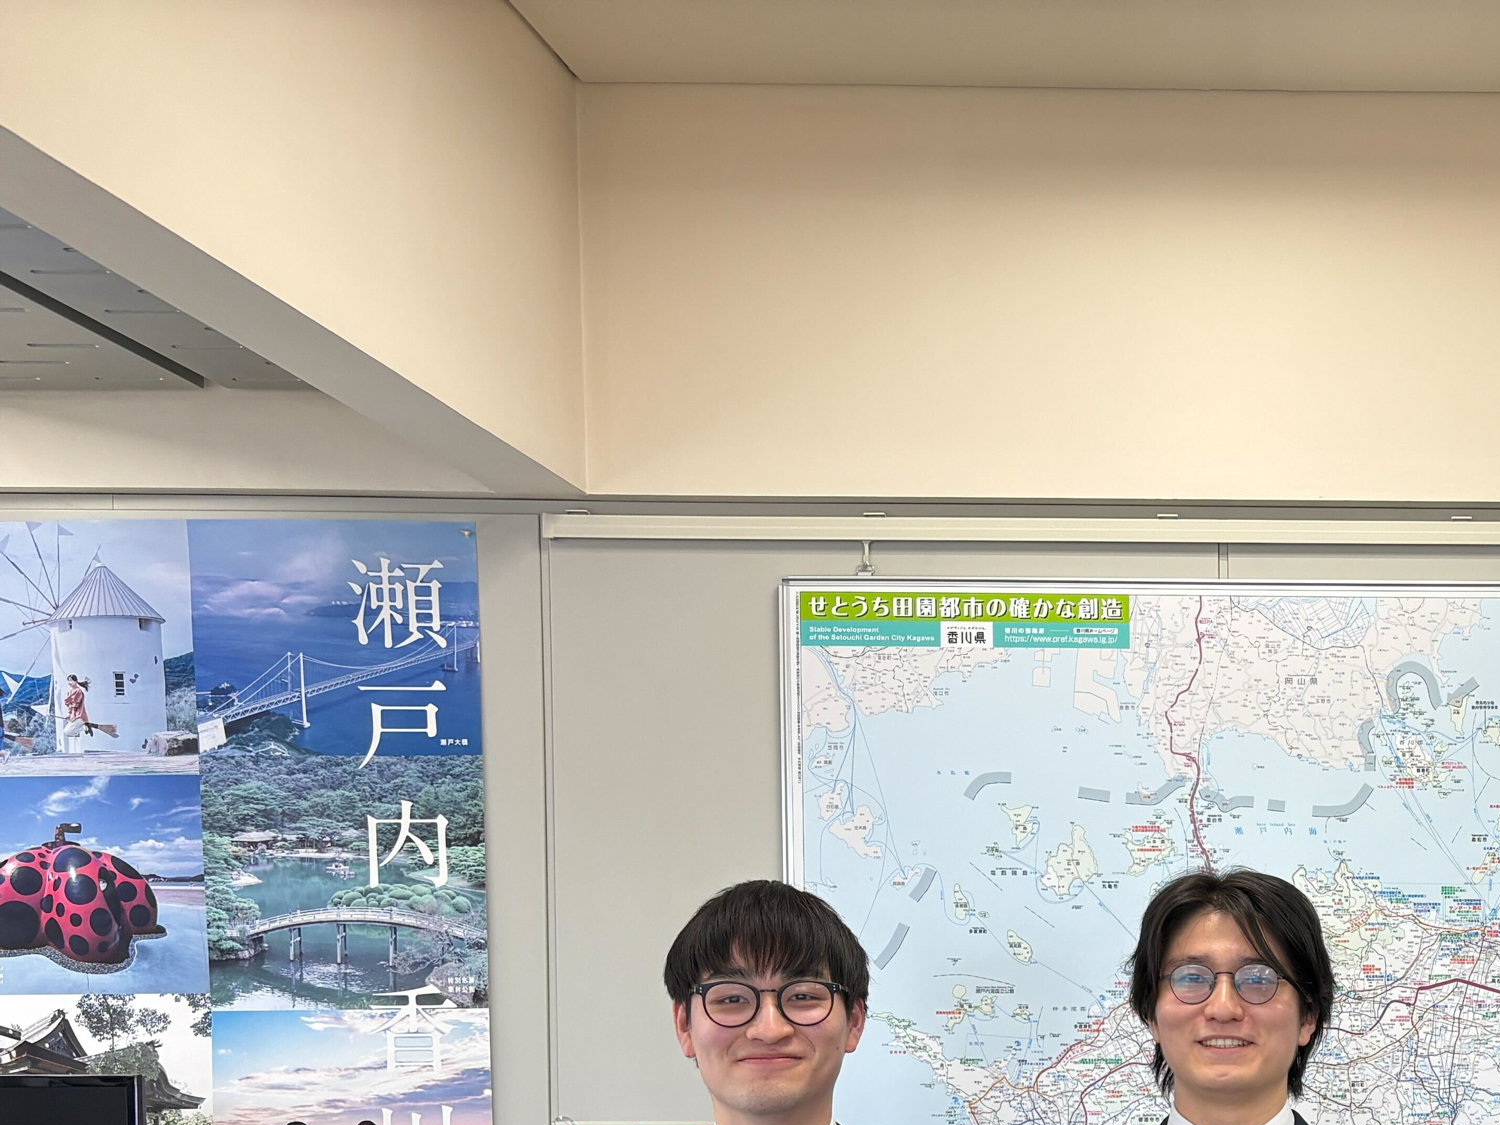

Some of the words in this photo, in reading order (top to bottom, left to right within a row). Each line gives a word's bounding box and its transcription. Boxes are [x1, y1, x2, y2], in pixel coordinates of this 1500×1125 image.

[808, 595, 1123, 620] せとうち田園都市の確かな創造
[833, 626, 879, 634] Development
[891, 634, 905, 643] City
[907, 634, 935, 642] Kagawa
[947, 631, 987, 644] 香川県
[1004, 635, 1118, 644] https://www.pref.kagawa.lg.jp/
[1284, 677, 1318, 686] 岡山県
[347, 557, 450, 889] 瀬戸内
[440, 738, 468, 746] 瀬戸大橋
